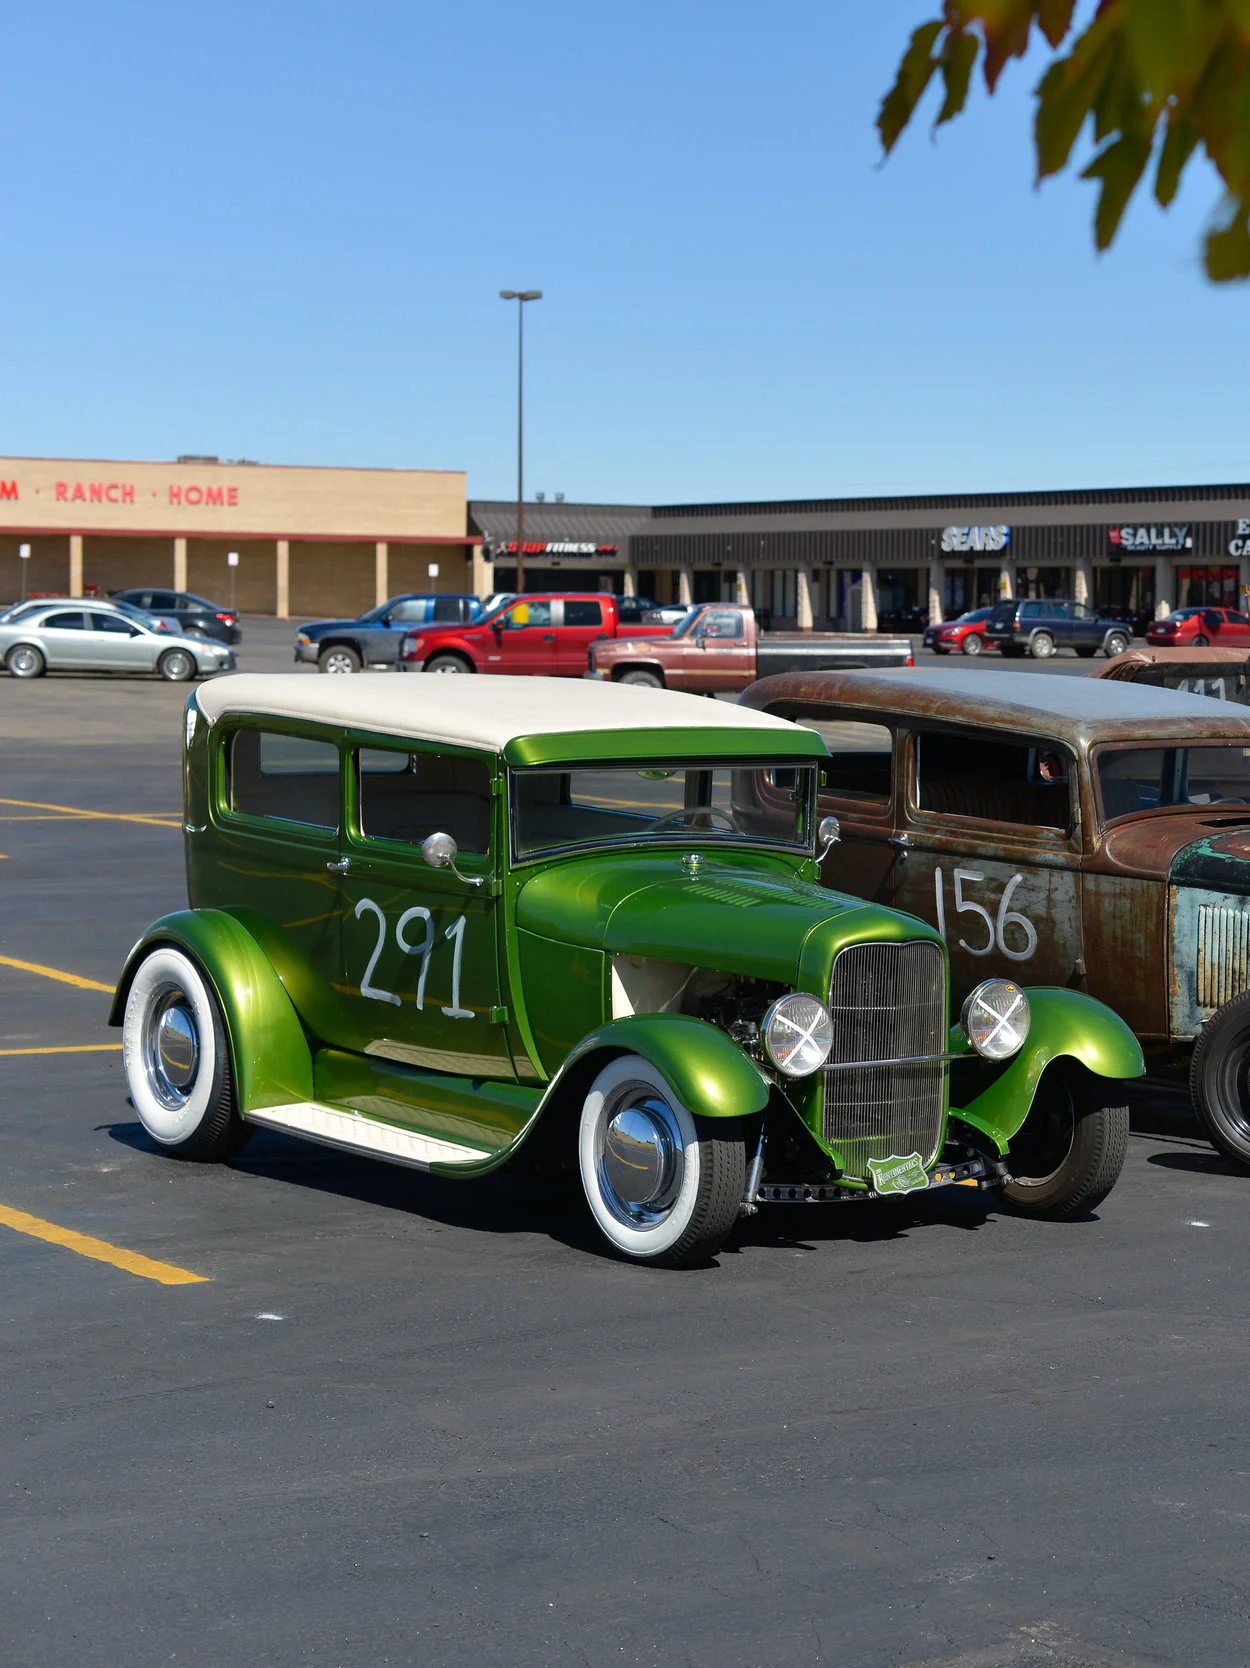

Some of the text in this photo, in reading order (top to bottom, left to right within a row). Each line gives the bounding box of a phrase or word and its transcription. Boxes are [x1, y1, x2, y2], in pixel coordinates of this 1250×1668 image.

[55, 481, 135, 503] RANCH
[169, 484, 239, 505] HOME
[941, 524, 1010, 552] SEARS
[1120, 527, 1188, 545] SALLY
[935, 867, 1038, 961] 156
[355, 898, 476, 1019] 291
